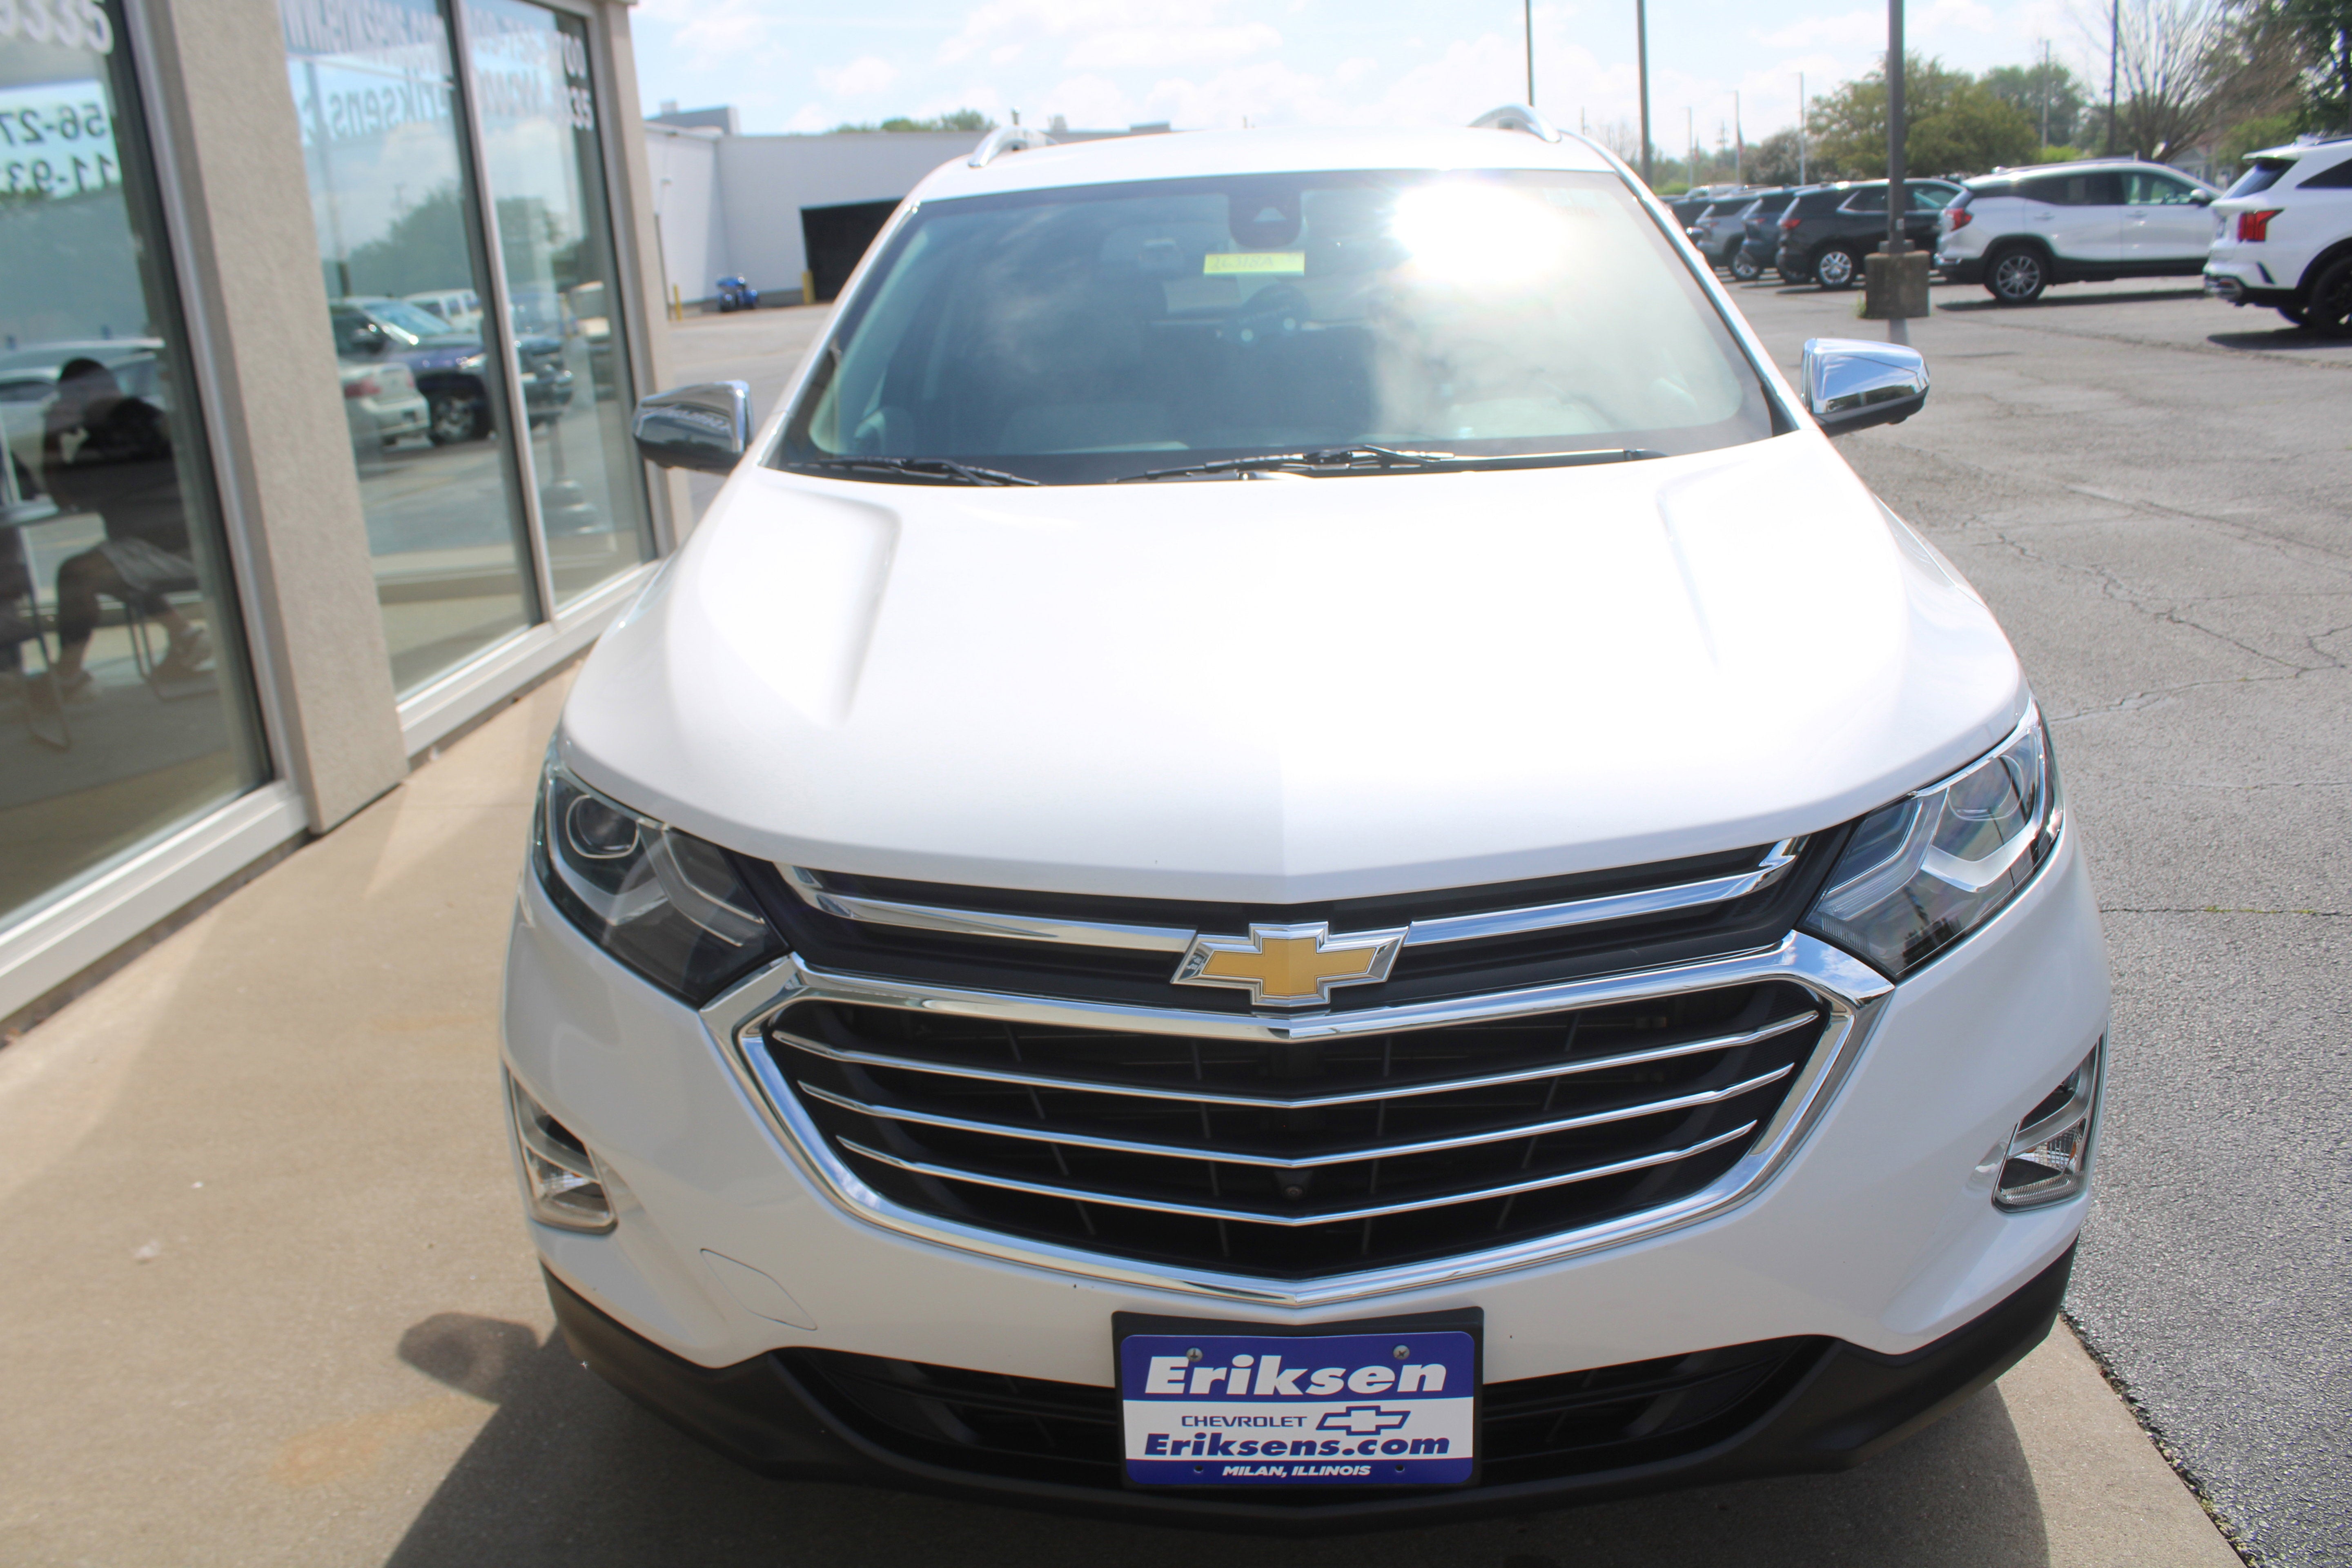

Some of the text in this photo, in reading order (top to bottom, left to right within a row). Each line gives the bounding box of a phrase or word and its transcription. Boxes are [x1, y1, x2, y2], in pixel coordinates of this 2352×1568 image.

[1145, 1355, 1446, 1396] Eriksen
[1181, 1416, 1307, 1428] CHEVROLET
[1145, 1433, 1450, 1457] Eriksens.com
[1222, 1466, 1371, 1478] MILAN, ILLINOIS
